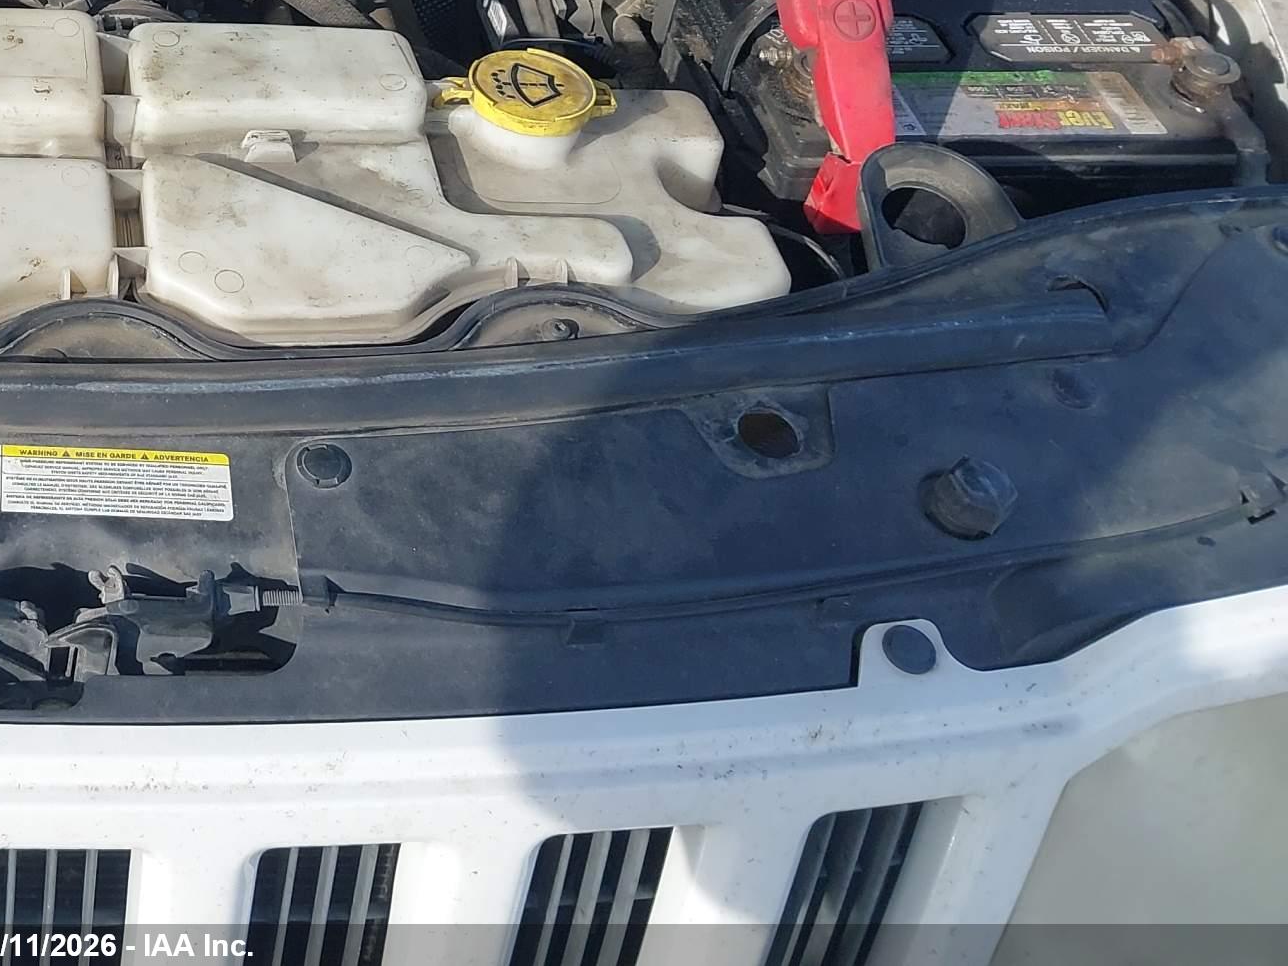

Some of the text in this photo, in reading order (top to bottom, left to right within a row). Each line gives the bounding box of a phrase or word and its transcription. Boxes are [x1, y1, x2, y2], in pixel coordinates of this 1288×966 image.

[19, 449, 58, 457] WARNING
[108, 452, 137, 460] GARDE
[153, 454, 209, 462] ADVERTENCIA
